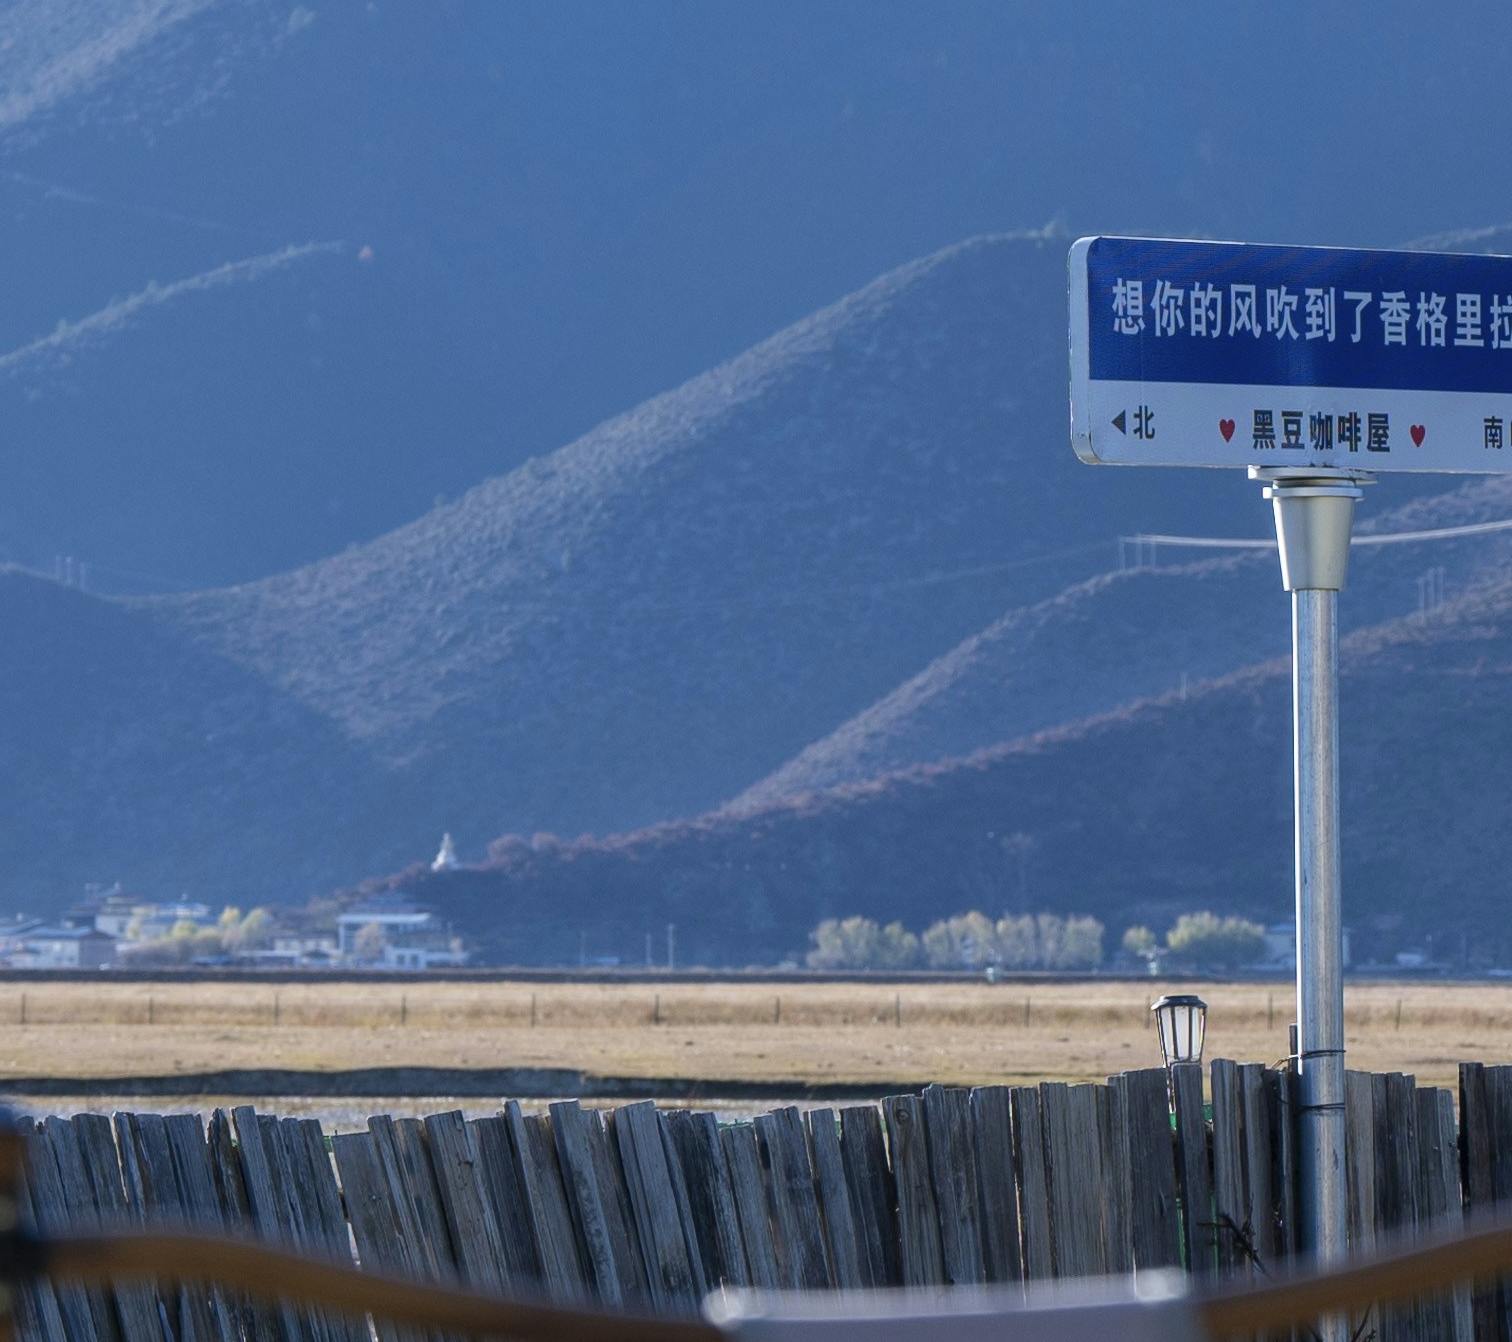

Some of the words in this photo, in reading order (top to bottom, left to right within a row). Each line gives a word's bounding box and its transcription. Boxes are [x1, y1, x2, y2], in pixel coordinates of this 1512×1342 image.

[1133, 405, 1155, 440] 北
[1252, 409, 1391, 453] 黑豆咖啡屋
[1483, 416, 1503, 449] 南
